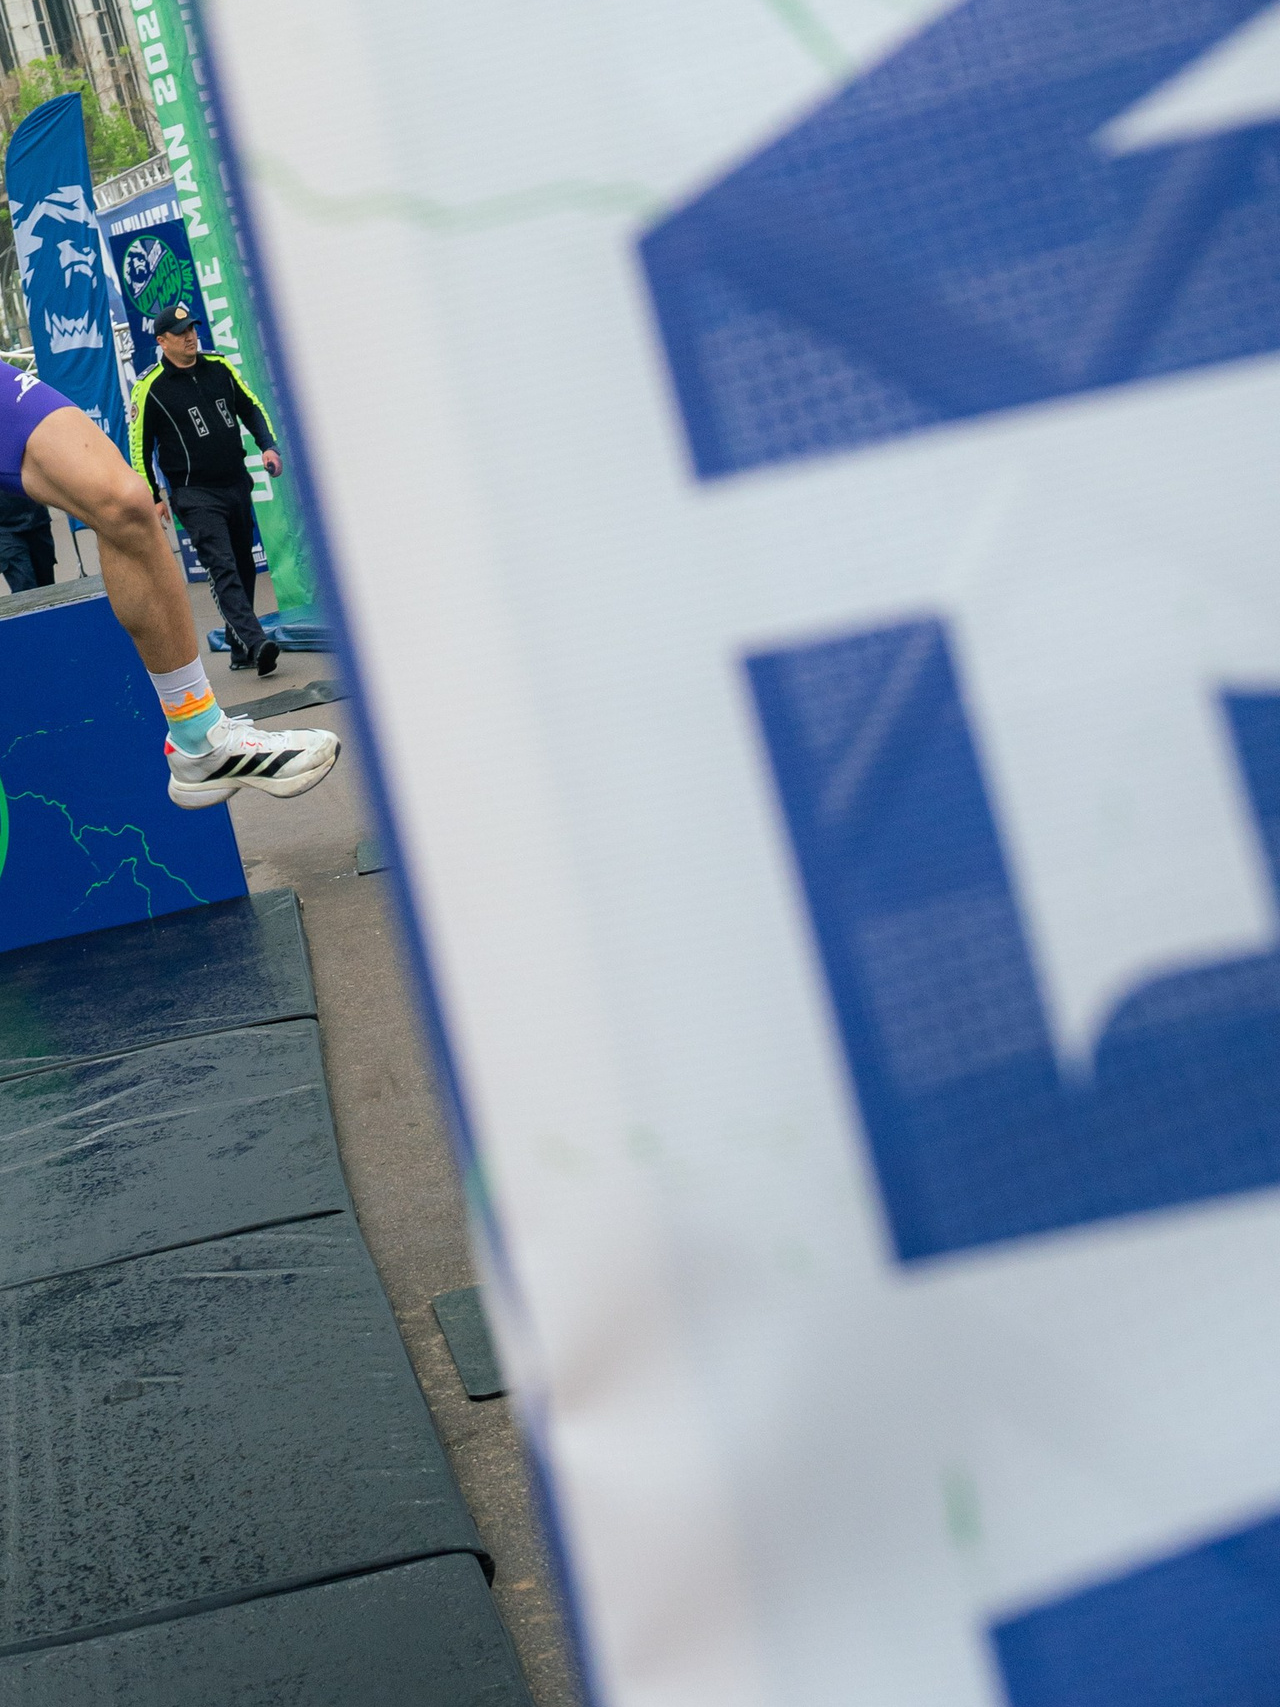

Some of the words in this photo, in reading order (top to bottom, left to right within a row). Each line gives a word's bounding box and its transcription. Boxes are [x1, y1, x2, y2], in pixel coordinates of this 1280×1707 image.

[162, 123, 210, 239] MAN
[179, 258, 195, 294] MAY
[196, 256, 274, 502] ULATE
